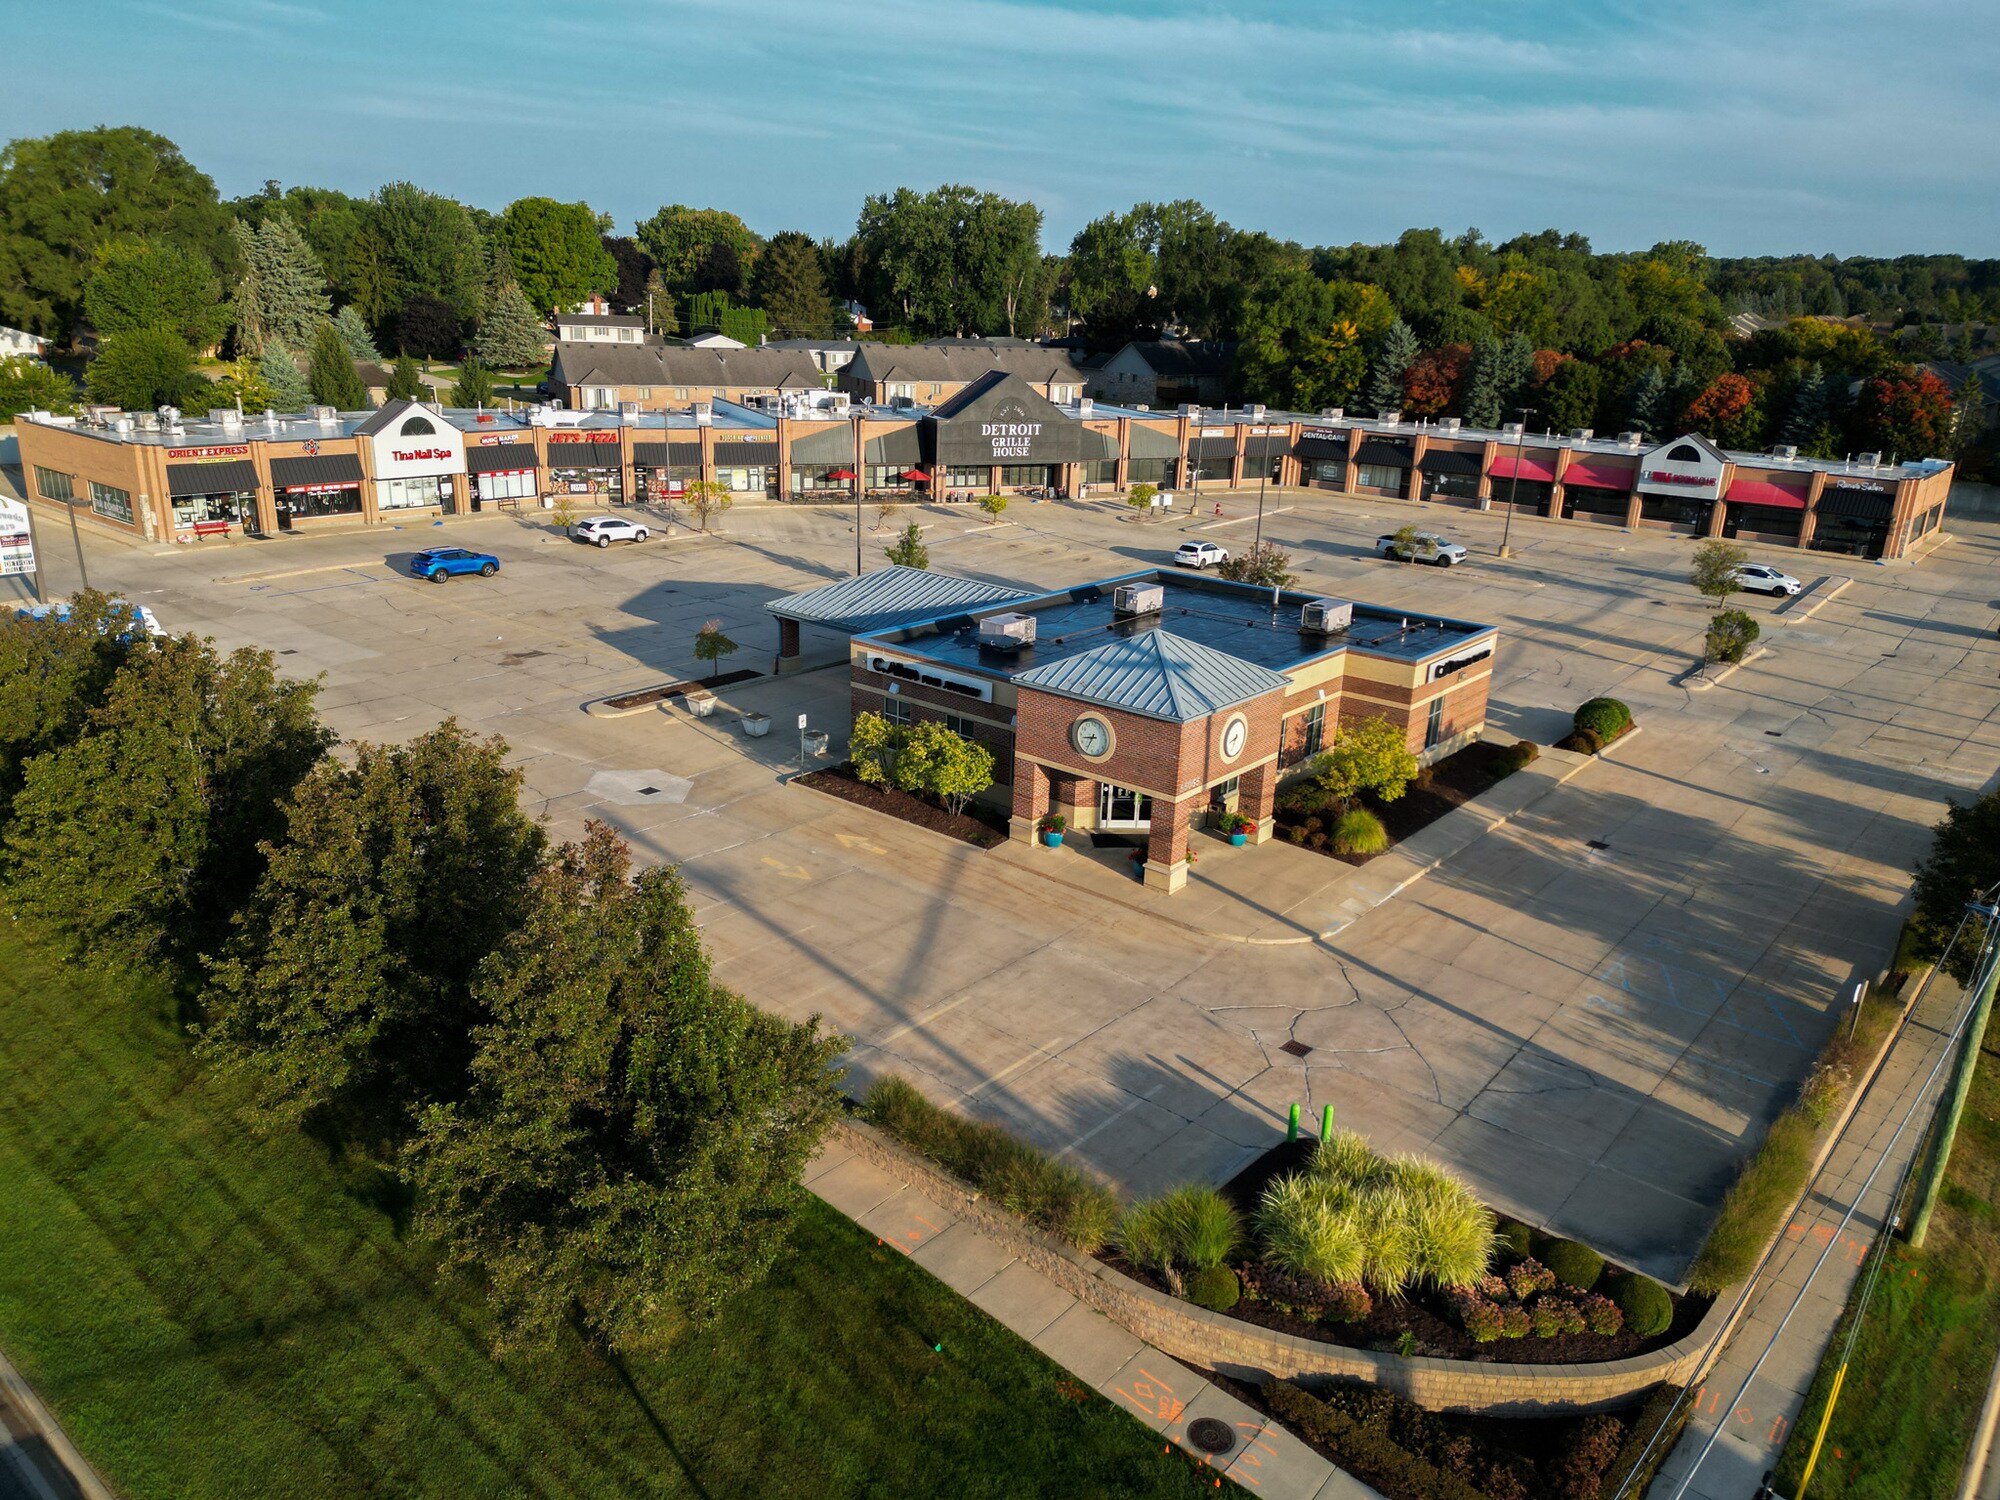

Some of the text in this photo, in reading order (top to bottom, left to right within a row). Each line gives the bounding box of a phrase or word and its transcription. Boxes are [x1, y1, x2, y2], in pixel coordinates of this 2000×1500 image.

[982, 424, 1041, 436] DETROIT
[585, 433, 617, 443] PIZZA
[1303, 432, 1326, 440] DENTAL
[992, 437, 1031, 447] GRILLE
[168, 446, 248, 458] ORIENT EXPRESS
[392, 448, 452, 461] Tina Nail Spa
[993, 447, 1029, 457] HOUSE
